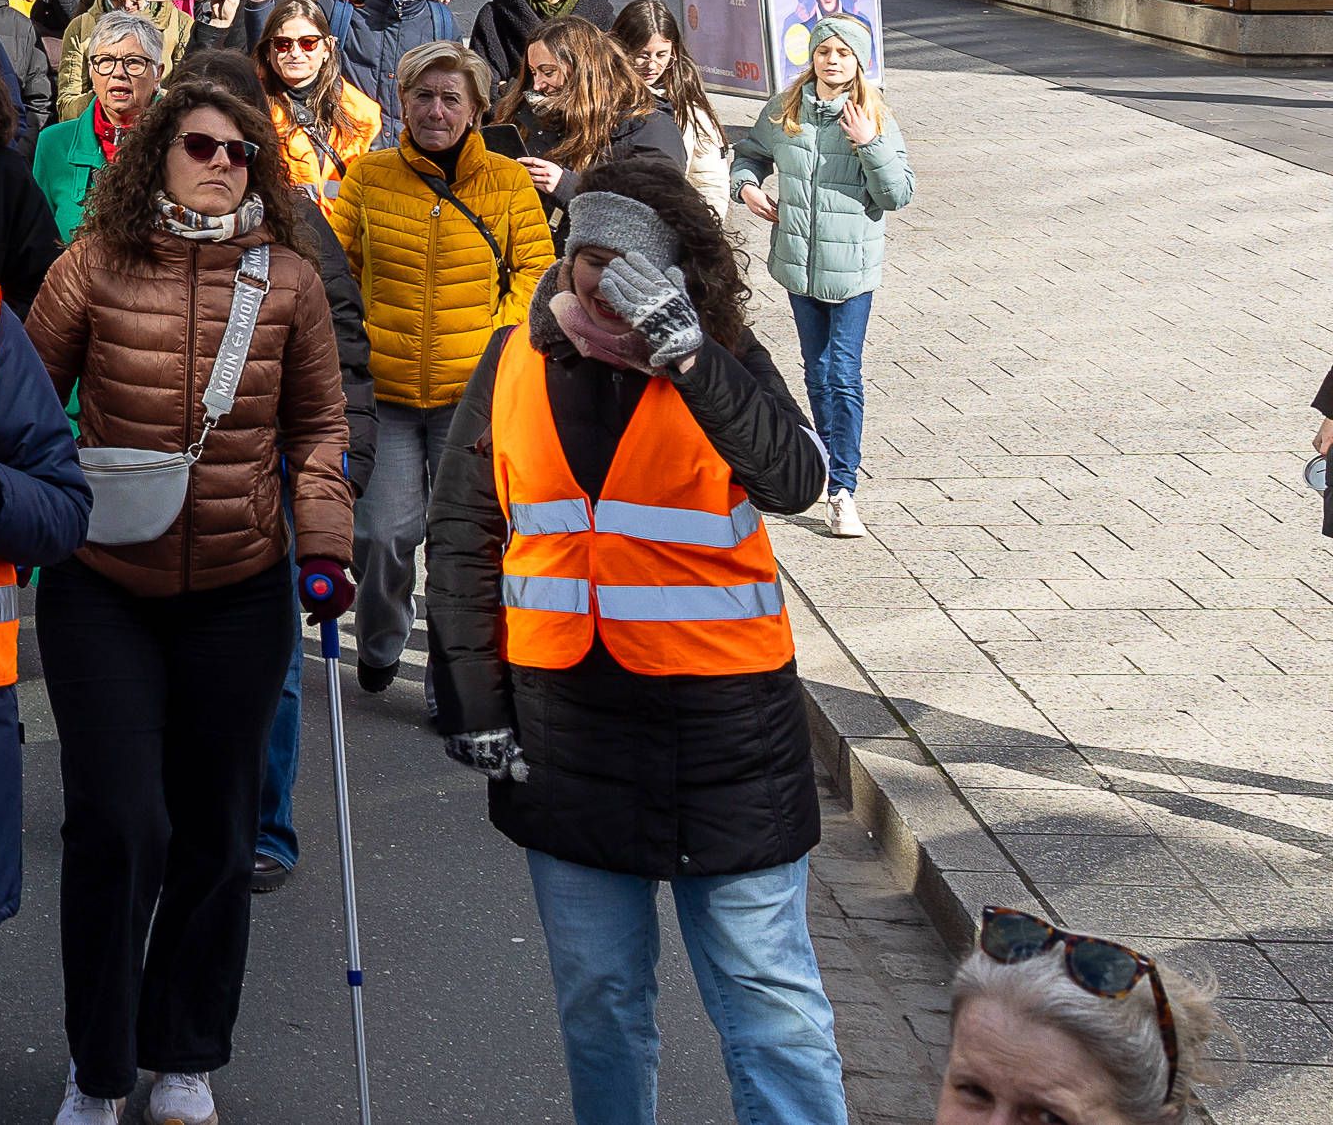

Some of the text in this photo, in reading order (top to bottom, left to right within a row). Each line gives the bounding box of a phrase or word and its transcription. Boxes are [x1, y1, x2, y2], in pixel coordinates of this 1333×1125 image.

[735, 59, 760, 81] SPD
[236, 286, 259, 329] MOIN
[216, 353, 239, 396] MOIN
